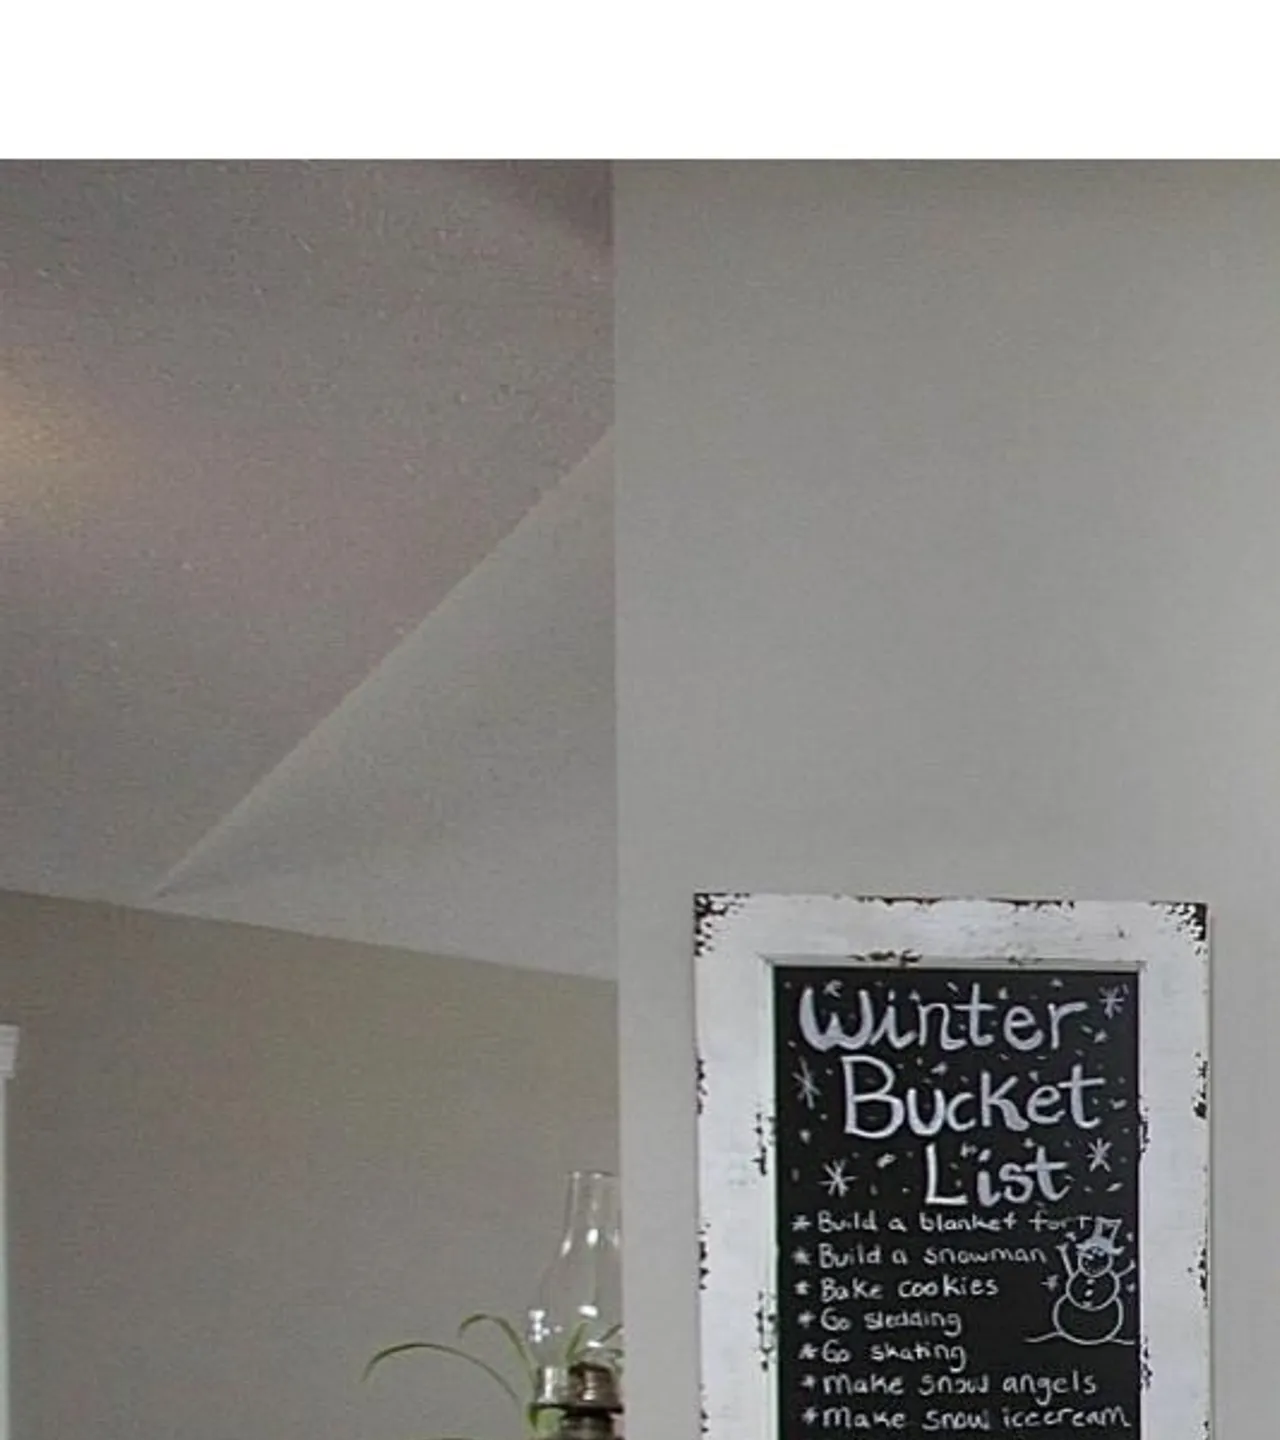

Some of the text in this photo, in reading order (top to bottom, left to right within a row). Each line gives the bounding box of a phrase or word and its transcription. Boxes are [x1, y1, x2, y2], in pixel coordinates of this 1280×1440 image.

[799, 982, 1089, 1051] Winter
[841, 1054, 1106, 1140] Bucket
[924, 1142, 1071, 1208] List
[817, 1211, 878, 1233] Build
[888, 1215, 907, 1233] a
[919, 1211, 1018, 1232] blanket
[818, 1244, 1048, 1269] Build a snowman
[820, 1274, 1000, 1301] Bake cookies
[820, 1307, 962, 1337] Go sledding
[821, 1340, 967, 1373] Go skating
[918, 1374, 990, 1397] snow
[1002, 1369, 1098, 1406] angels
[921, 1408, 991, 1431] snow
